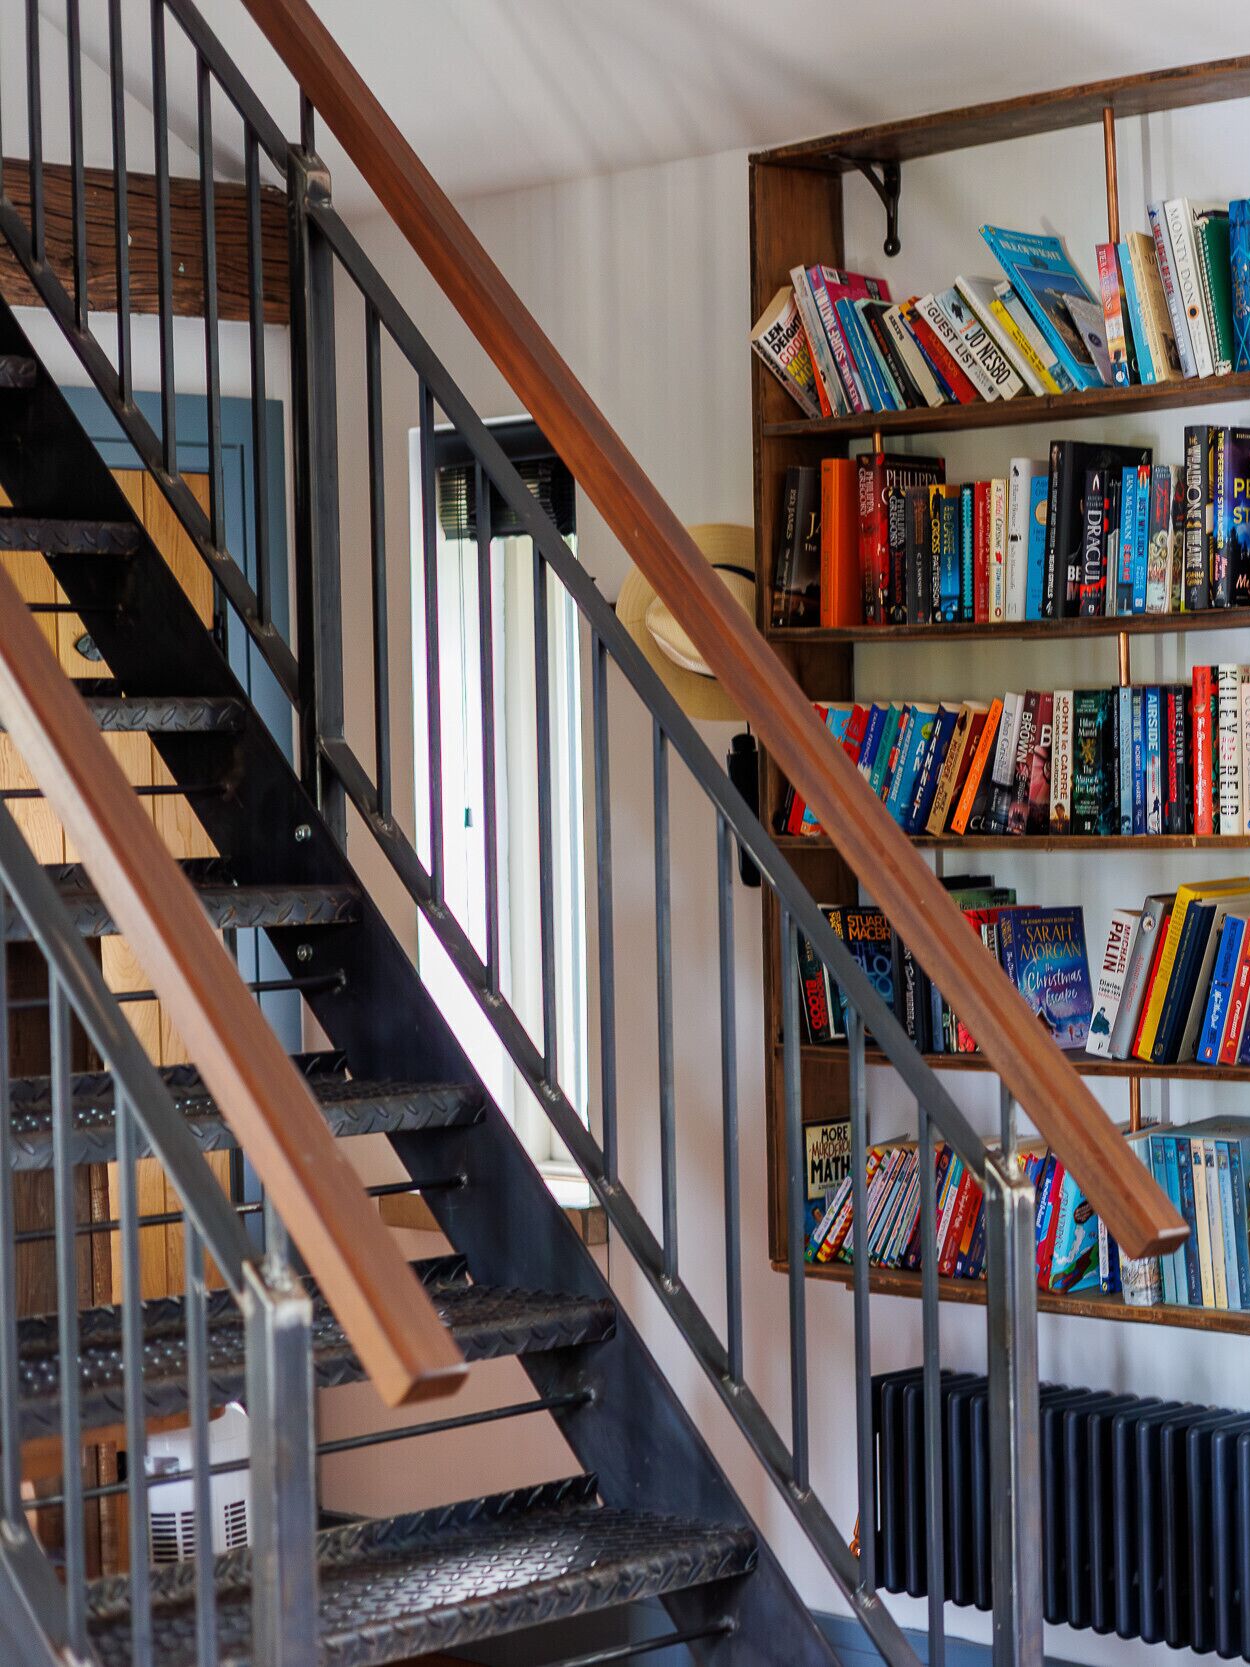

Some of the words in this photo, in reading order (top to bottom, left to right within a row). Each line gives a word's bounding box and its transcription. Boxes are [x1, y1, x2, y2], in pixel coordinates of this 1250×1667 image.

[1167, 207, 1189, 261] MONTY
[1178, 268, 1196, 304] DON
[812, 287, 837, 330] NATION
[763, 322, 784, 345] LEN
[827, 327, 847, 362] SURF
[927, 305, 958, 343] GUEST
[954, 342, 977, 369] LIST
[964, 327, 986, 348] JO
[858, 468, 866, 516] GREGORY
[886, 469, 938, 487] PHILIPPA
[1186, 444, 1200, 518] WHALEBONE
[1216, 452, 1224, 494] PERFECT
[783, 506, 796, 540] JAMES
[932, 518, 940, 553] CROSS
[1216, 496, 1224, 549] STRANGER
[1082, 508, 1105, 586] DRACUL
[1186, 528, 1200, 568] THEATRE
[1061, 696, 1069, 734] JOHN
[1219, 671, 1237, 733] KILEY
[1014, 711, 1034, 763] BROWN
[1147, 694, 1157, 751] AIRSIDE
[1060, 739, 1067, 749] le
[1175, 730, 1184, 764] FLYNN
[910, 718, 942, 819] HAMNET
[1220, 764, 1238, 815] REID
[848, 926, 891, 941] MACBR
[1019, 941, 1082, 961] MORGAN
[1025, 923, 1072, 942] SARAH
[1103, 920, 1123, 973] PALIN
[1117, 924, 1132, 974] MICHAEL
[1027, 968, 1082, 992] Christmas
[1045, 986, 1078, 1007] Escape
[805, 979, 822, 1030] BLOOD
[820, 1125, 849, 1142] MORE
[810, 1156, 852, 1184] MATH
